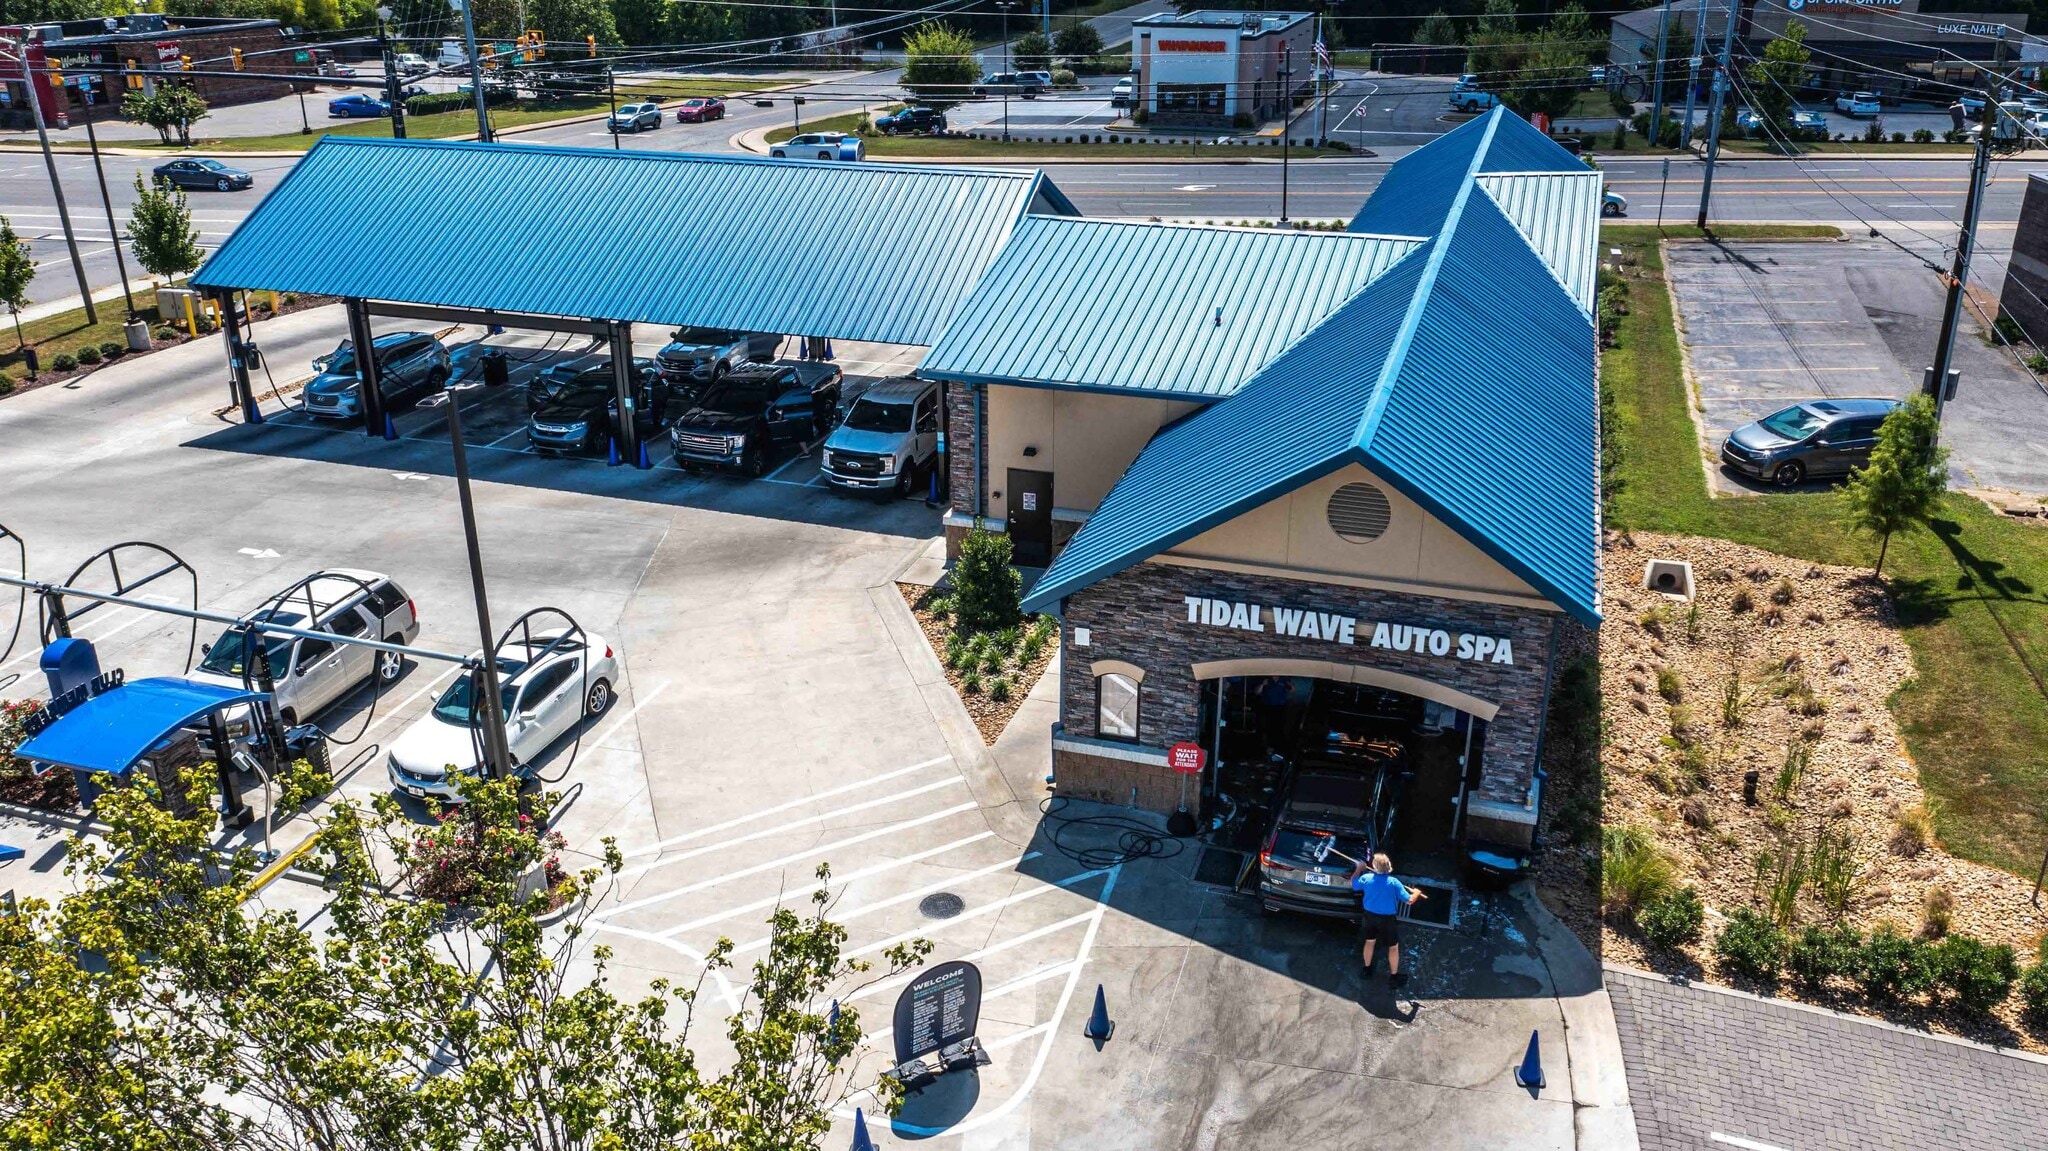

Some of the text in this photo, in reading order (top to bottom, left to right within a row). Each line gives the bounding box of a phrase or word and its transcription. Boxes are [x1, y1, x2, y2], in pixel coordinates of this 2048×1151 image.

[1937, 24, 1967, 34] LUXE
[61, 53, 90, 68] Wendy's
[1184, 596, 1514, 665] TIDAL WAVE AUTO SPA
[1175, 752, 1199, 760] WAIT
[912, 968, 964, 992] WELCOME
